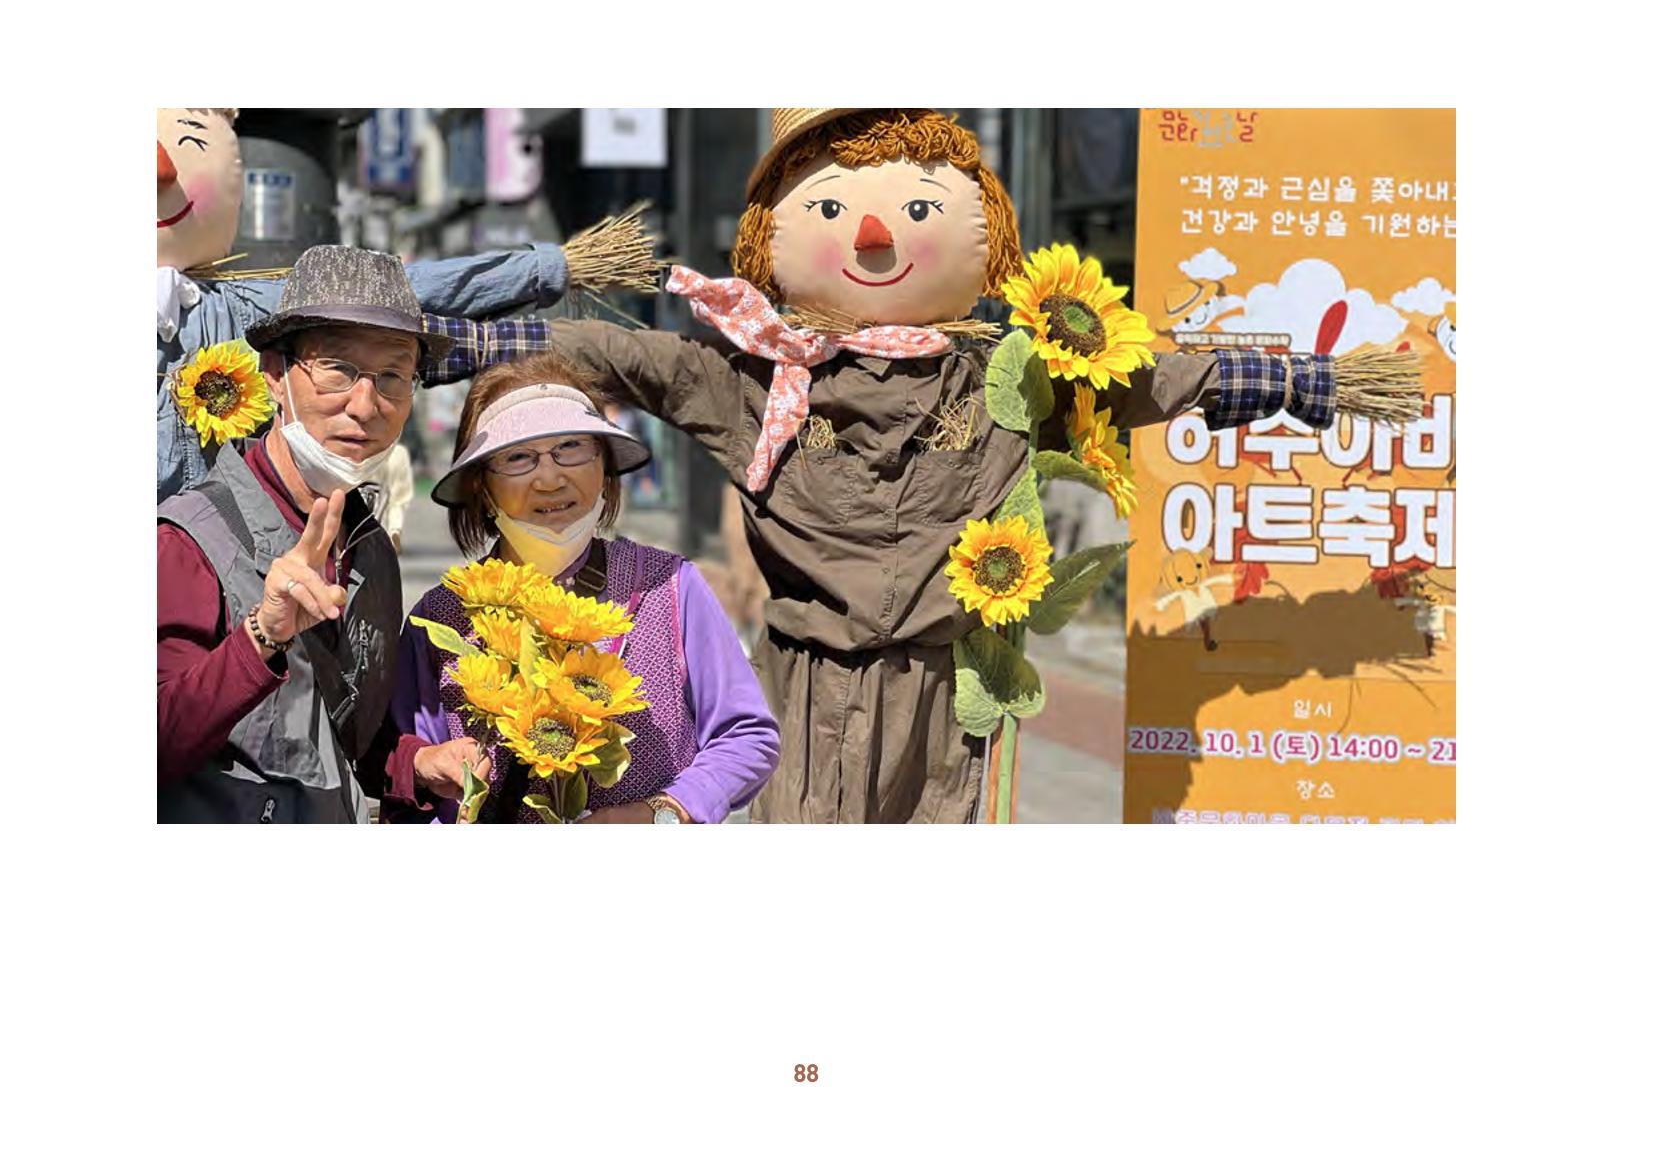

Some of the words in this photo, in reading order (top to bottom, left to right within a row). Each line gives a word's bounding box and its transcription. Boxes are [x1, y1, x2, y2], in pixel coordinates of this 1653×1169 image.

[1280, 176, 1358, 204] 근심을
[1181, 209, 1259, 235] 건강과
[1271, 209, 1347, 237] 안녕을
[1162, 483, 1457, 569] 아트축제
[1292, 699, 1333, 719] 일시
[1130, 730, 1198, 754] 2022.
[1205, 732, 1242, 755] 10.
[1251, 734, 1264, 754] 1
[1272, 732, 1320, 760] (토)
[1329, 736, 1399, 759] 14:00
[1296, 779, 1336, 800] 장소
[794, 1063, 819, 1083] 88
